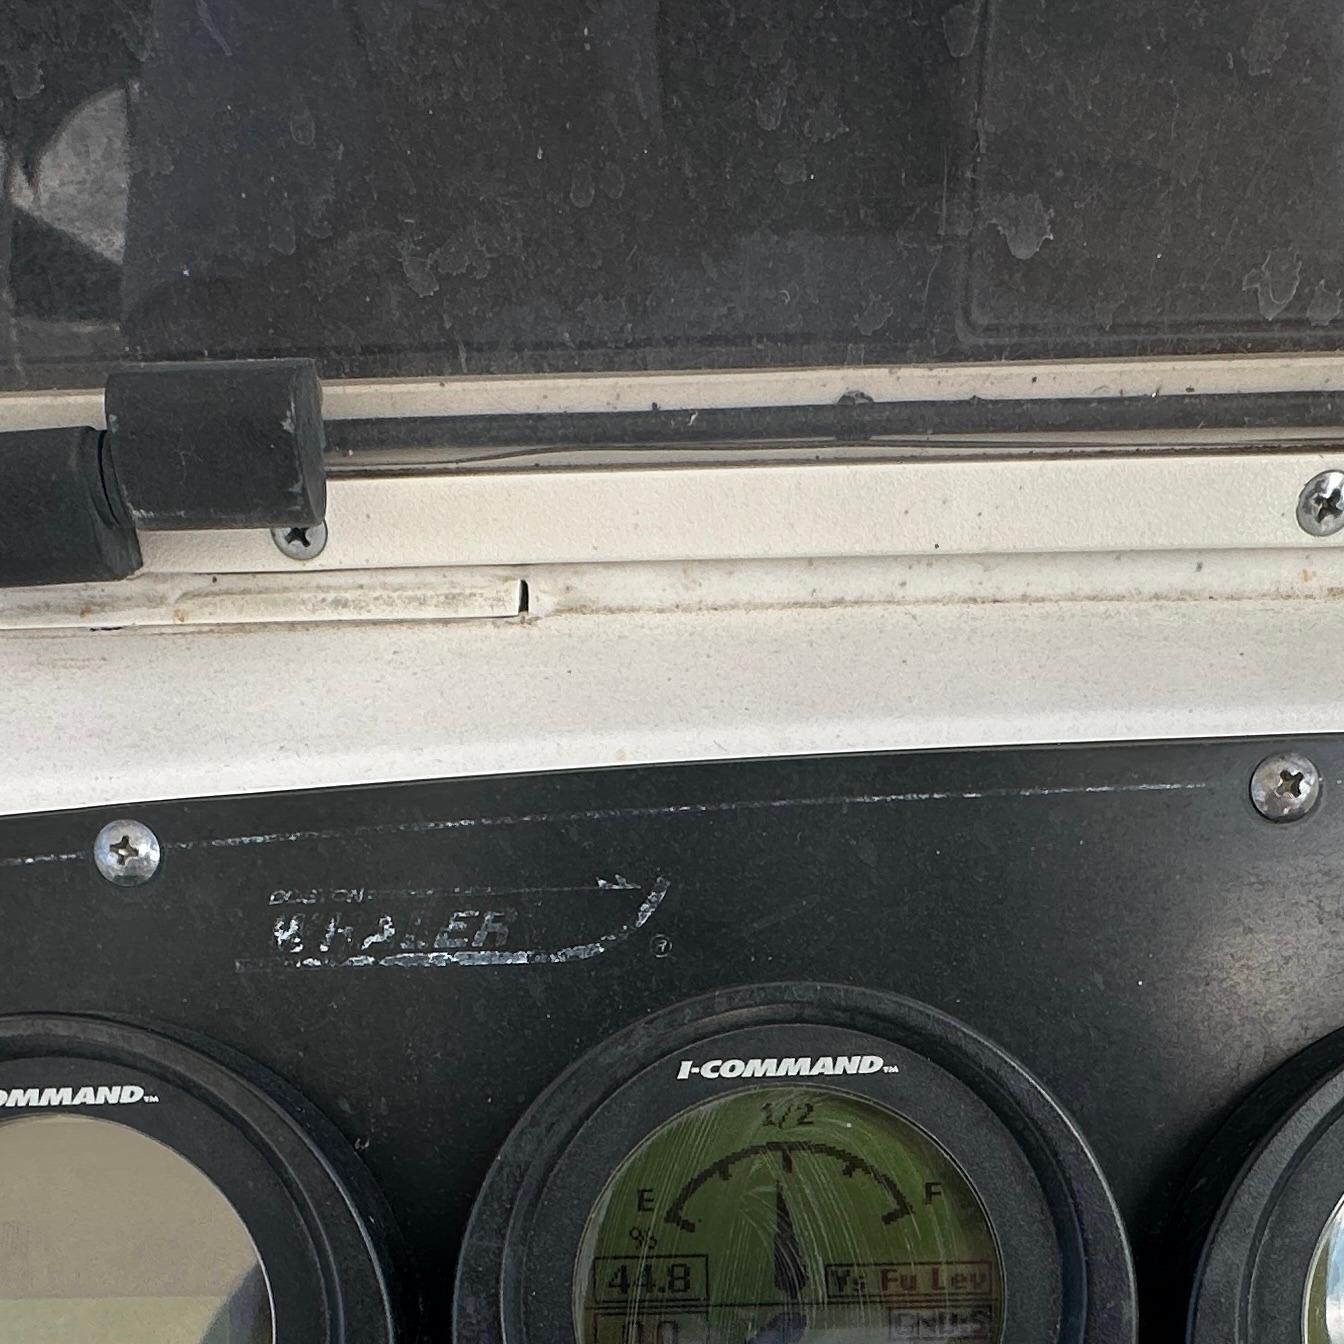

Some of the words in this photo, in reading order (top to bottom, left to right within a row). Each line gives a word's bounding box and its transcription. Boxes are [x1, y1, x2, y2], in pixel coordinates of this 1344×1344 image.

[636, 1188, 654, 1213] E
[924, 1182, 942, 1206] F
[607, 1264, 692, 1294] 44.8
[880, 1268, 917, 1292] Fu
[931, 1267, 987, 1291] Lev
